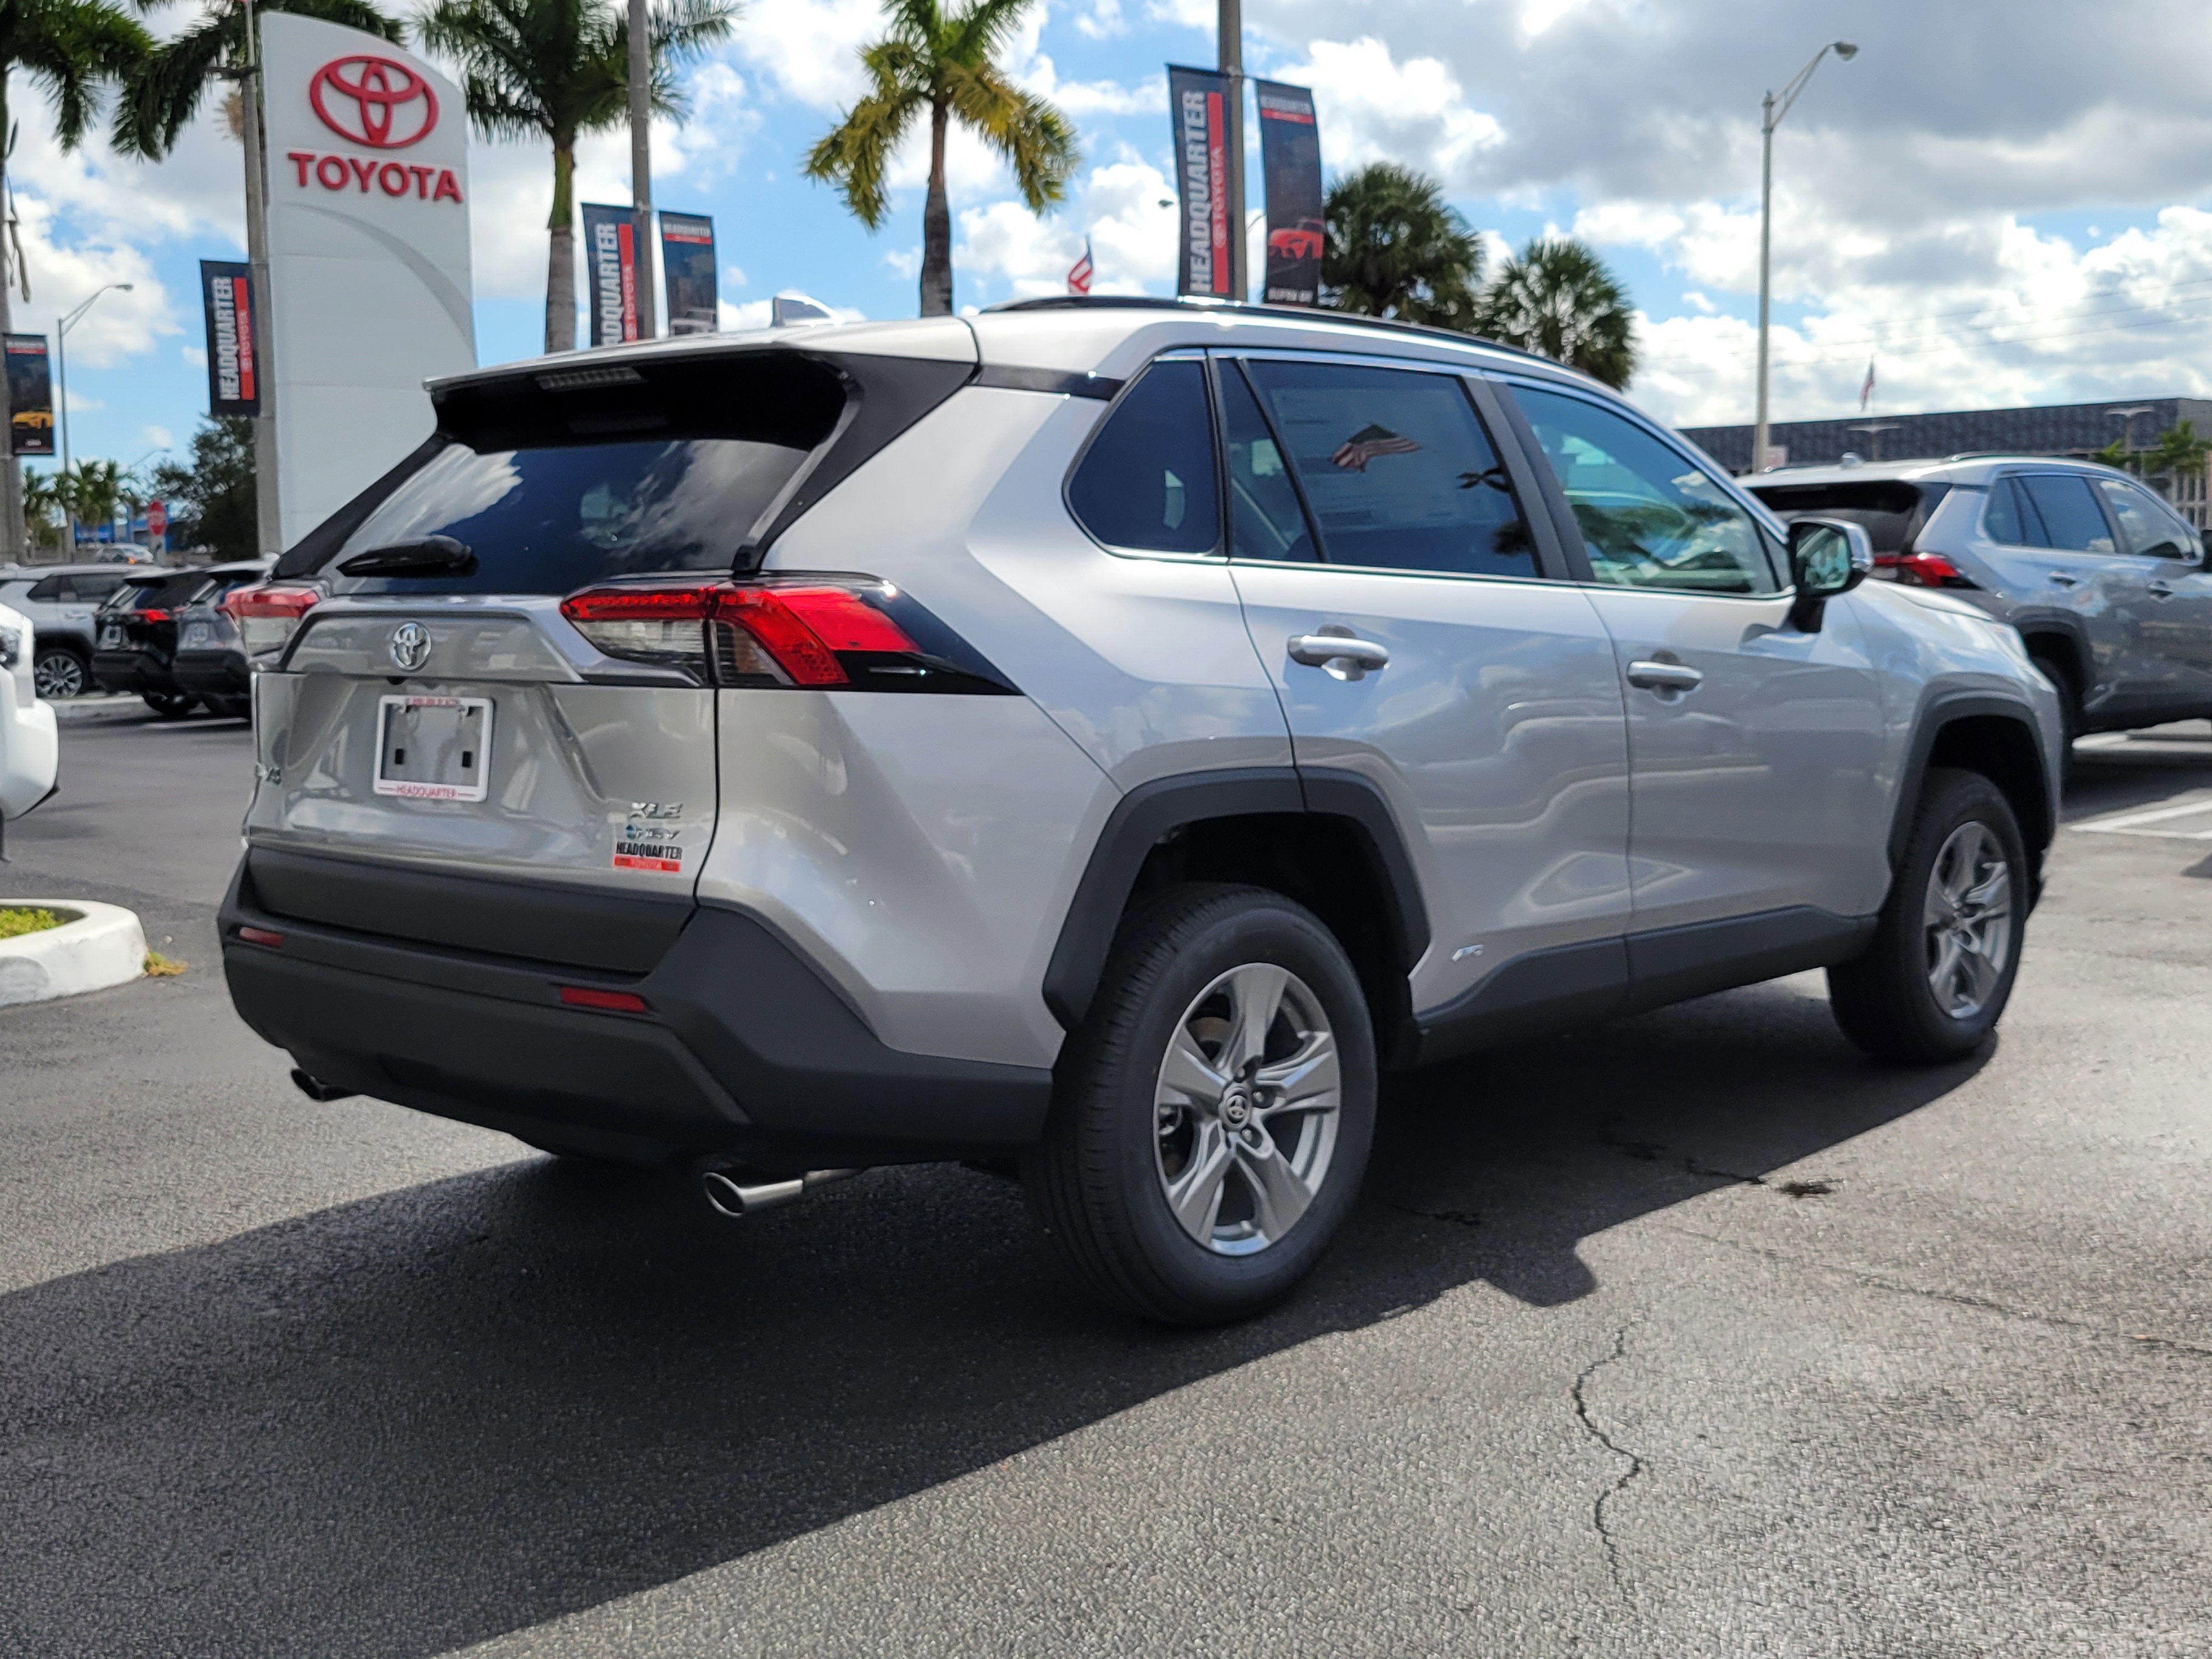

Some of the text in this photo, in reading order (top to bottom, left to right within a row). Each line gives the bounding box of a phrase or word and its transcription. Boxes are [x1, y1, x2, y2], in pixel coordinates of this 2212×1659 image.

[288, 152, 463, 204] TOYOTA
[1182, 90, 1213, 293] HEADQUARTER
[1210, 146, 1226, 221] TOYOTA
[595, 222, 624, 346] ADQUARTER
[212, 276, 240, 400] HEADQUARTER
[396, 785, 457, 798] HEADQUARTER
[616, 841, 683, 860] HEADQUARTER
